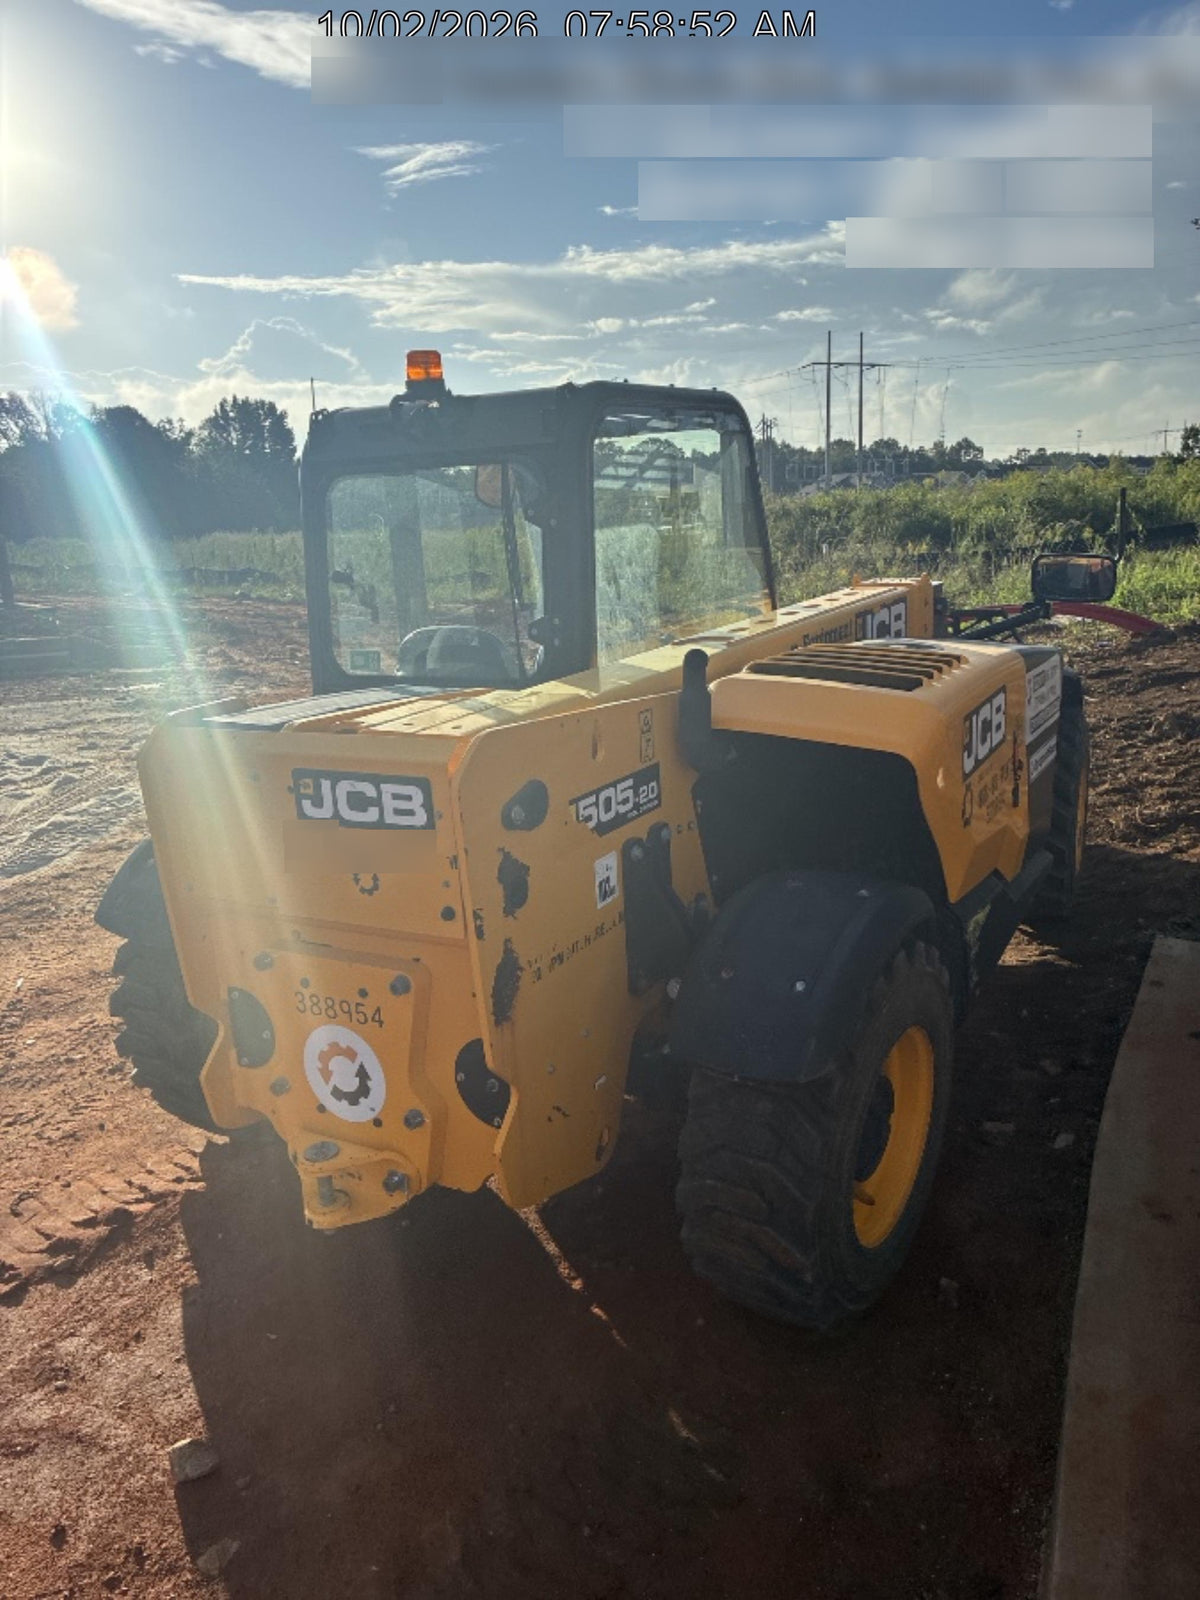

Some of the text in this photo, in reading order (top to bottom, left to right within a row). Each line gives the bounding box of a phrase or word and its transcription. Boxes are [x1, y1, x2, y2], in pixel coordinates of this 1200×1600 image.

[963, 691, 1006, 774] JCB
[301, 778, 428, 827] JCB
[294, 991, 385, 1028] 388954
